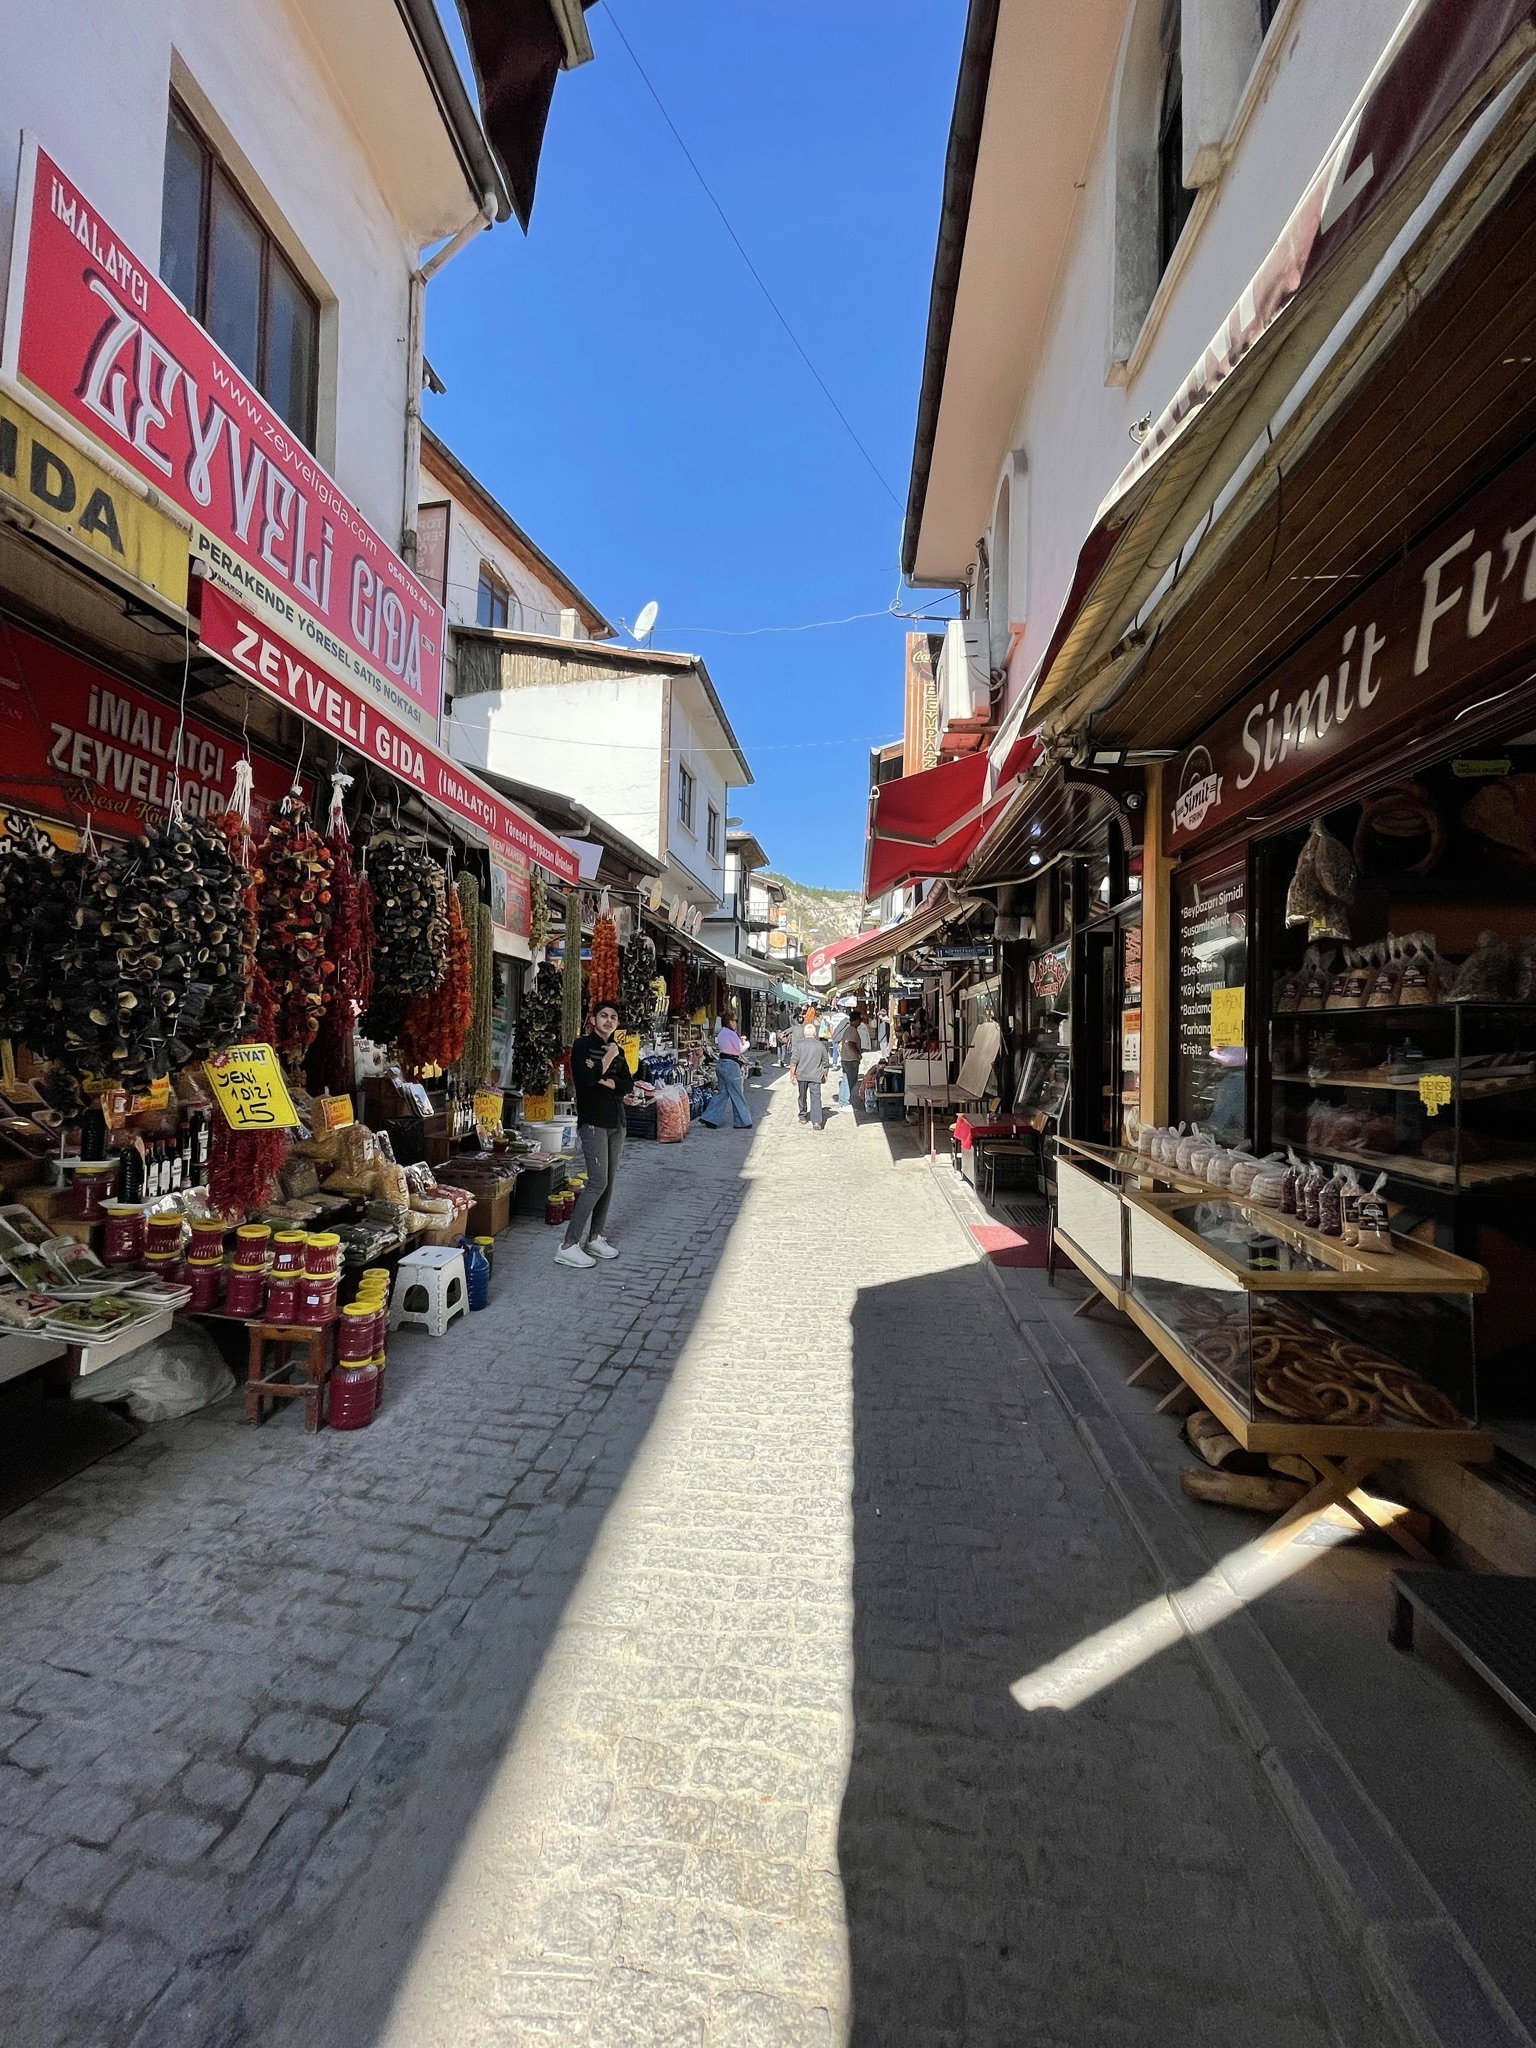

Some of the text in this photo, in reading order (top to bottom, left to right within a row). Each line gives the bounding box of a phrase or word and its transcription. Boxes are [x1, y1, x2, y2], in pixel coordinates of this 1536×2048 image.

[80, 277, 422, 696] ZEYVELİ GIDA
[212, 361, 378, 557] www.zeyveligida.com
[199, 533, 294, 623] PERAKENDE
[298, 613, 351, 668] YÖRESEL
[353, 660, 382, 693] SATIŞ
[383, 684, 421, 723] NOKTASI
[88, 684, 225, 784] İMALATÇI
[232, 620, 367, 745] ZEYVELİ
[375, 725, 426, 785] GIDA
[438, 768, 497, 830] (İMALATÇI)
[504, 817, 528, 846] Yöresel
[1236, 622, 1386, 790] Simit
[47, 721, 175, 809] ZEYVELİ
[182, 779, 225, 820] GID
[1183, 781, 1210, 818] Simit
[1218, 883, 1244, 905] Simidi
[217, 1068, 256, 1087] YENİ
[231, 1050, 266, 1063] FİYAT
[240, 1082, 272, 1100] DİZİ
[236, 1102, 275, 1124] 15
